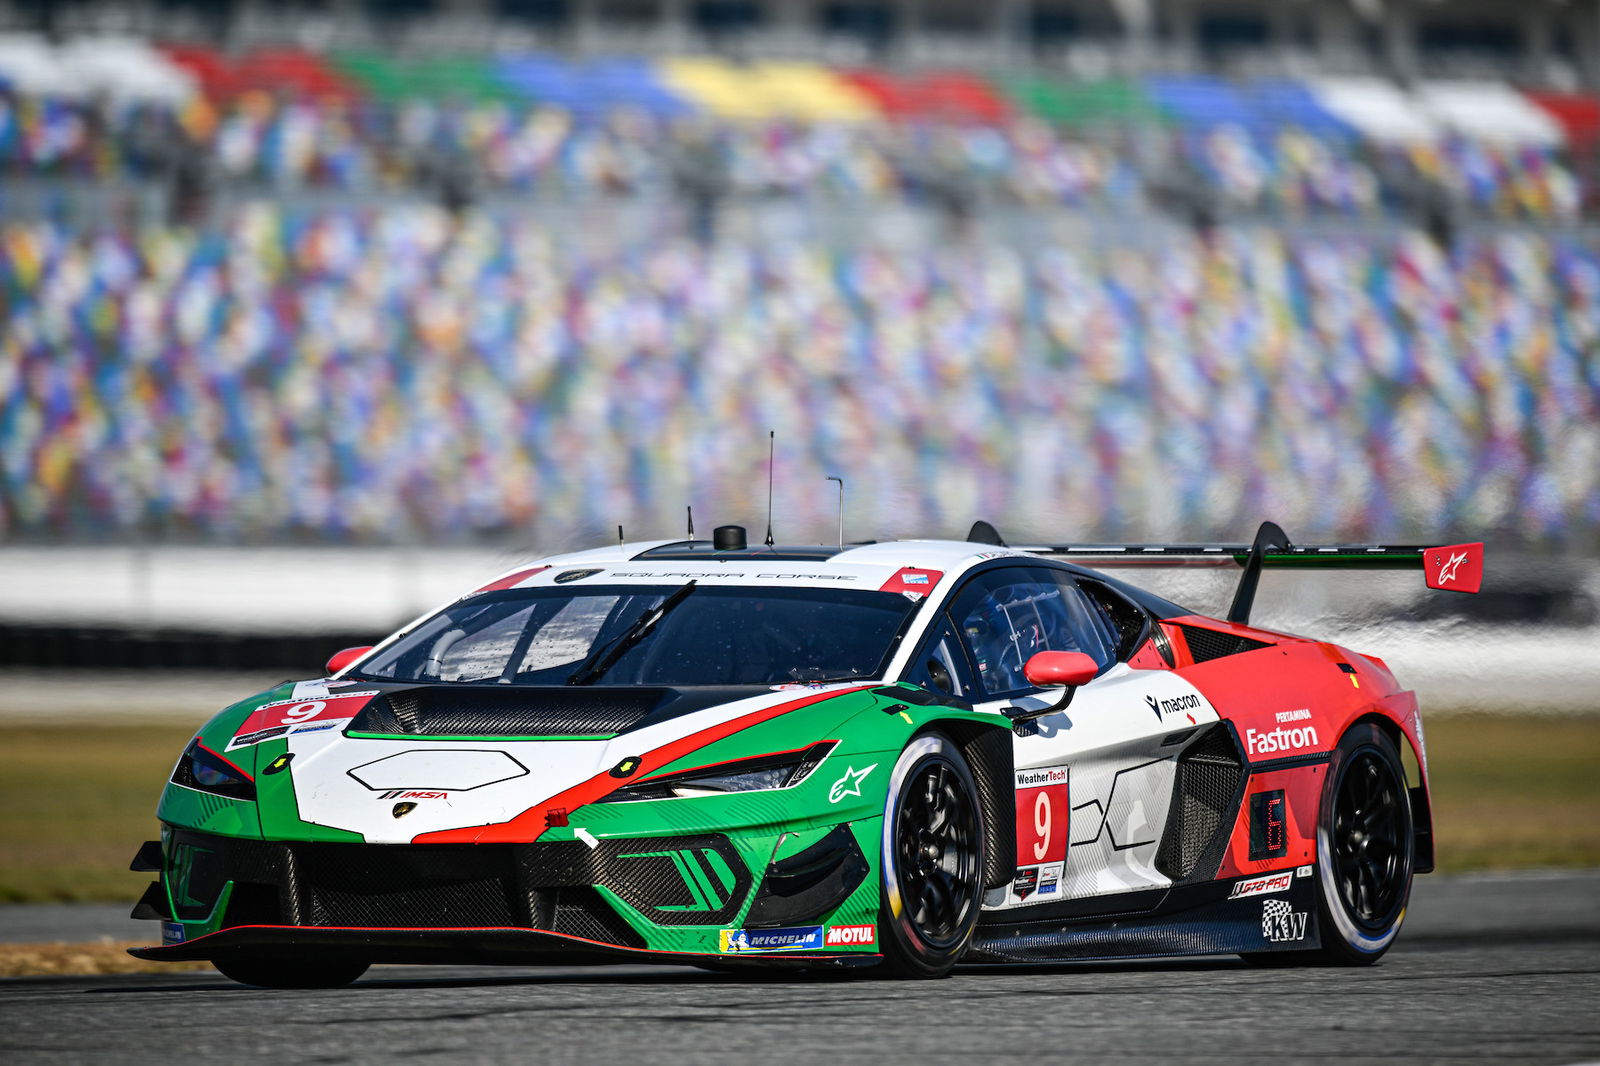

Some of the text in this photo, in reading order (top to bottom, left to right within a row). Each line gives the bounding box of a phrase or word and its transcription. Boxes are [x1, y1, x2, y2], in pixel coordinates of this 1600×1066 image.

[756, 573, 858, 581] CORSE
[281, 701, 326, 724] 9
[1161, 694, 1200, 714] macron
[1275, 709, 1312, 724] PERTAMINA
[1246, 726, 1318, 754] Fastron
[1017, 770, 1066, 785] WeatherTech
[400, 791, 448, 800] IMSA
[1033, 791, 1052, 861] 9
[1268, 799, 1281, 850] 6
[827, 927, 873, 944] MOTUL
[1270, 912, 1307, 942] KW
[751, 934, 815, 945] MICHELIN
